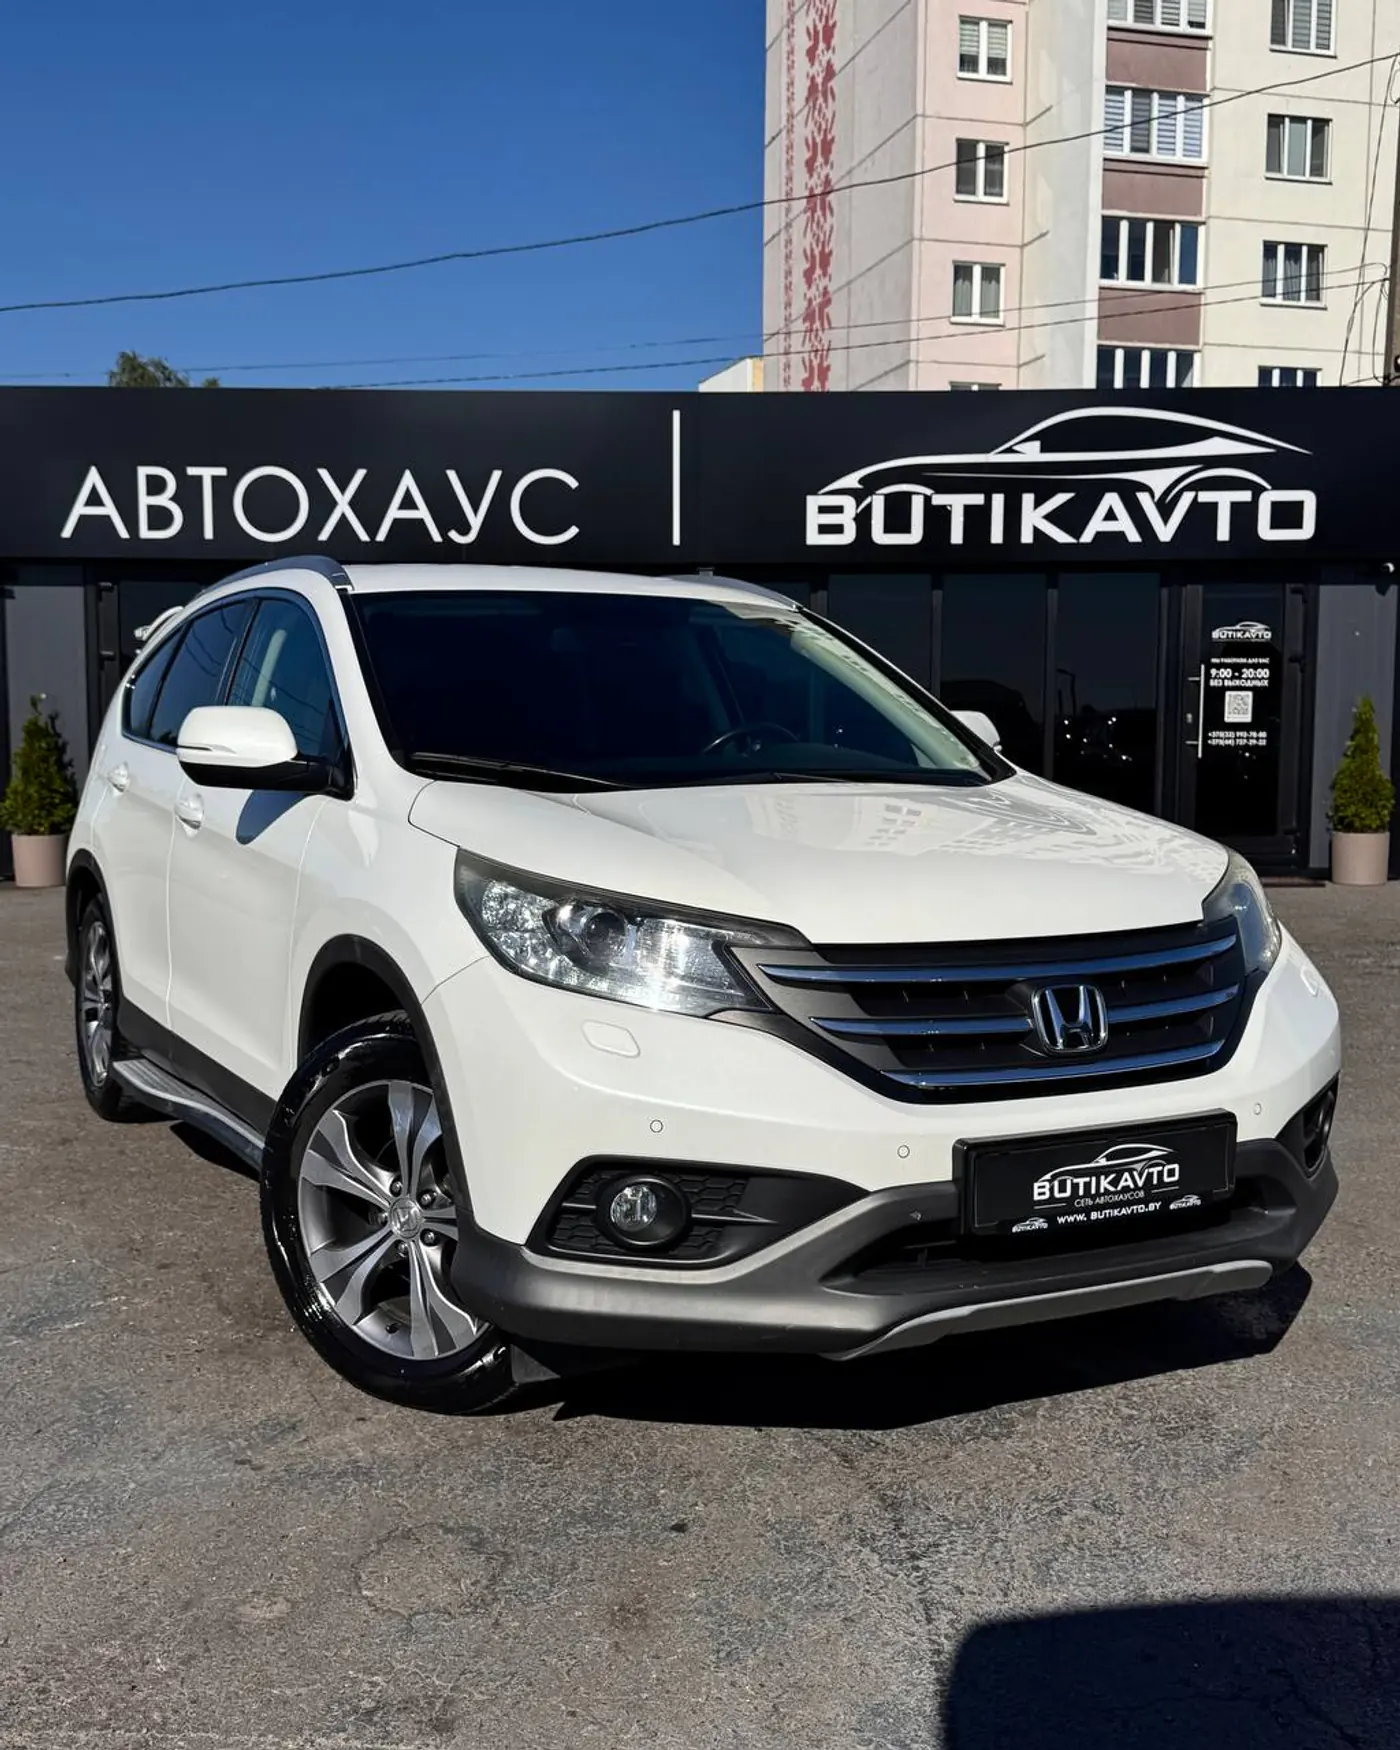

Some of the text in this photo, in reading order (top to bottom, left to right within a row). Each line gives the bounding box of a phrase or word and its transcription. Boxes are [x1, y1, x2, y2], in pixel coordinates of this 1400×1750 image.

[60, 464, 580, 545] АВТОХАУС
[805, 488, 1317, 546] BUTIKAVTO
[1211, 630, 1272, 639] BUTIKAVTO
[1210, 667, 1232, 679] 9:00
[1241, 667, 1270, 679] 20:00
[1209, 679, 1269, 687] БЕЗ ВЫХОДНЫХ
[1033, 1163, 1179, 1201] BUTIKAVTO
[1094, 1190, 1145, 1205] АВТОХАУСОВ
[1090, 1201, 1162, 1221] BUTIKAVTO.BY
